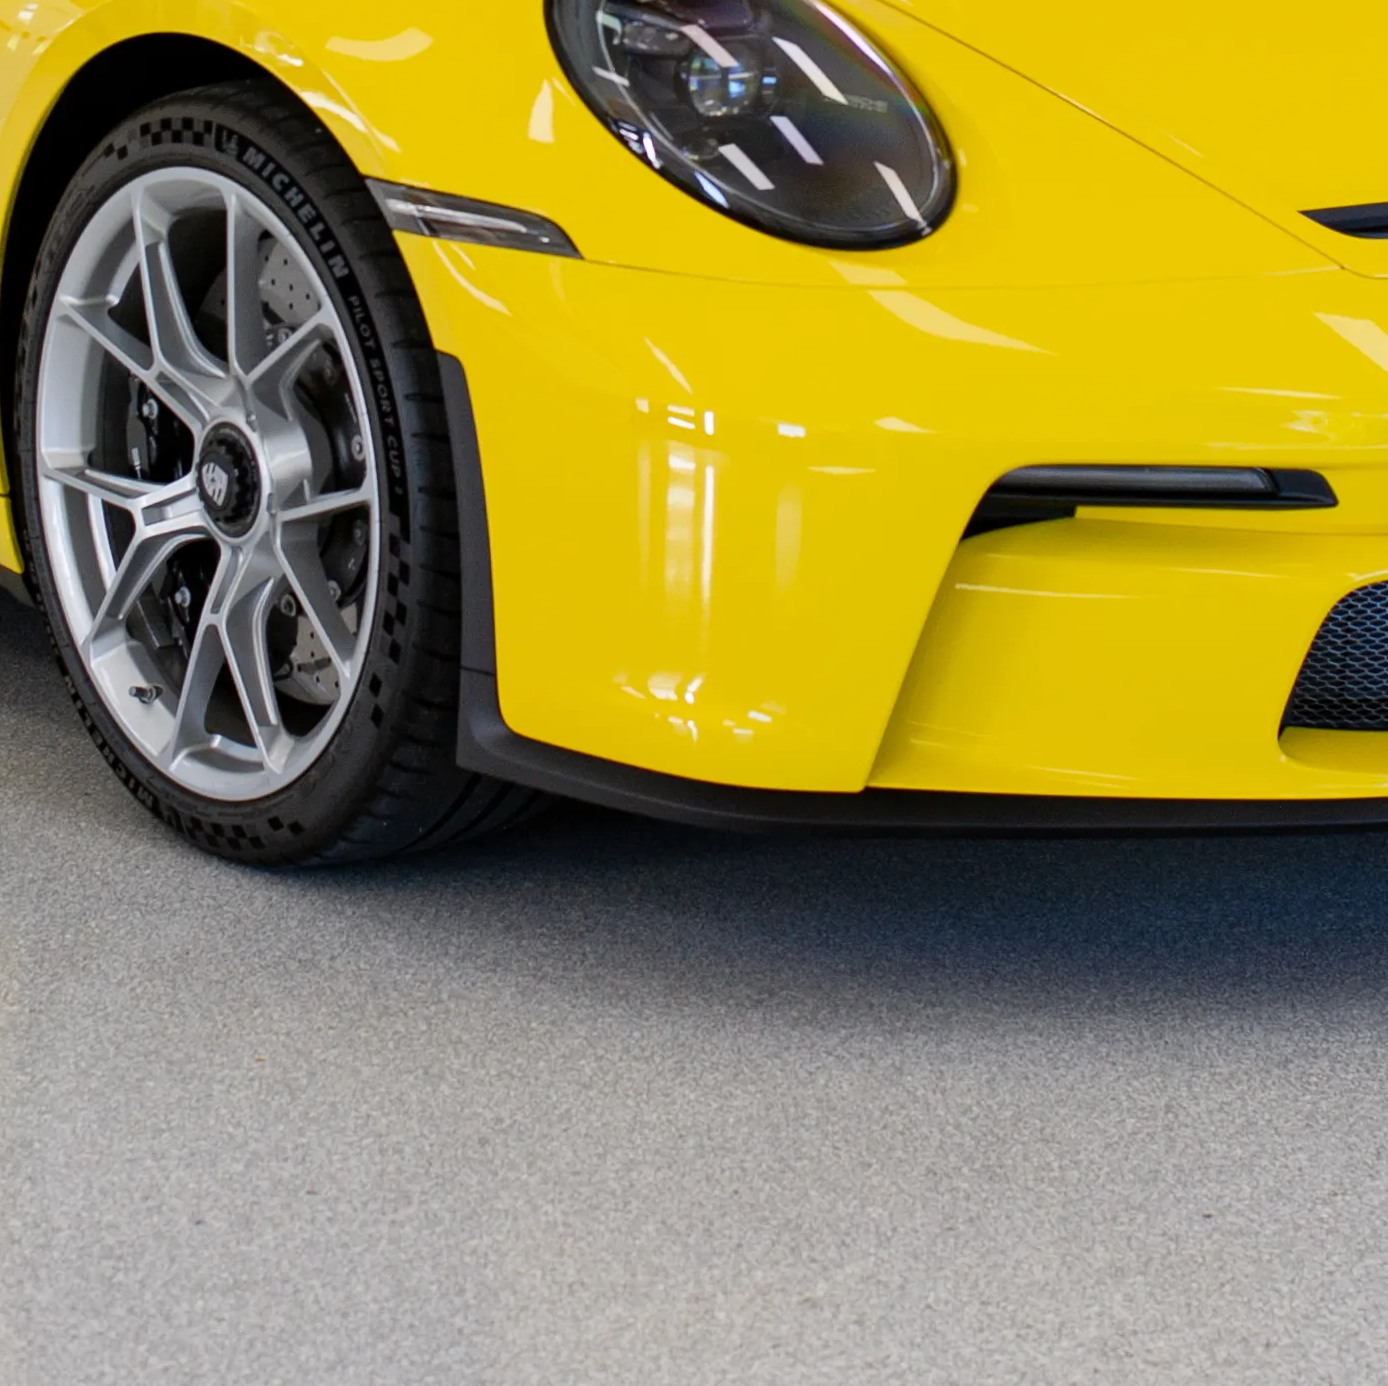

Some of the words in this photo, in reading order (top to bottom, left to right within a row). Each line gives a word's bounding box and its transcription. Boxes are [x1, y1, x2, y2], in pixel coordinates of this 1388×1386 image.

[243, 146, 349, 278] MICHELIN
[348, 295, 376, 350] PILOT
[370, 358, 395, 428] SPORT
[387, 435, 401, 479] CUP
